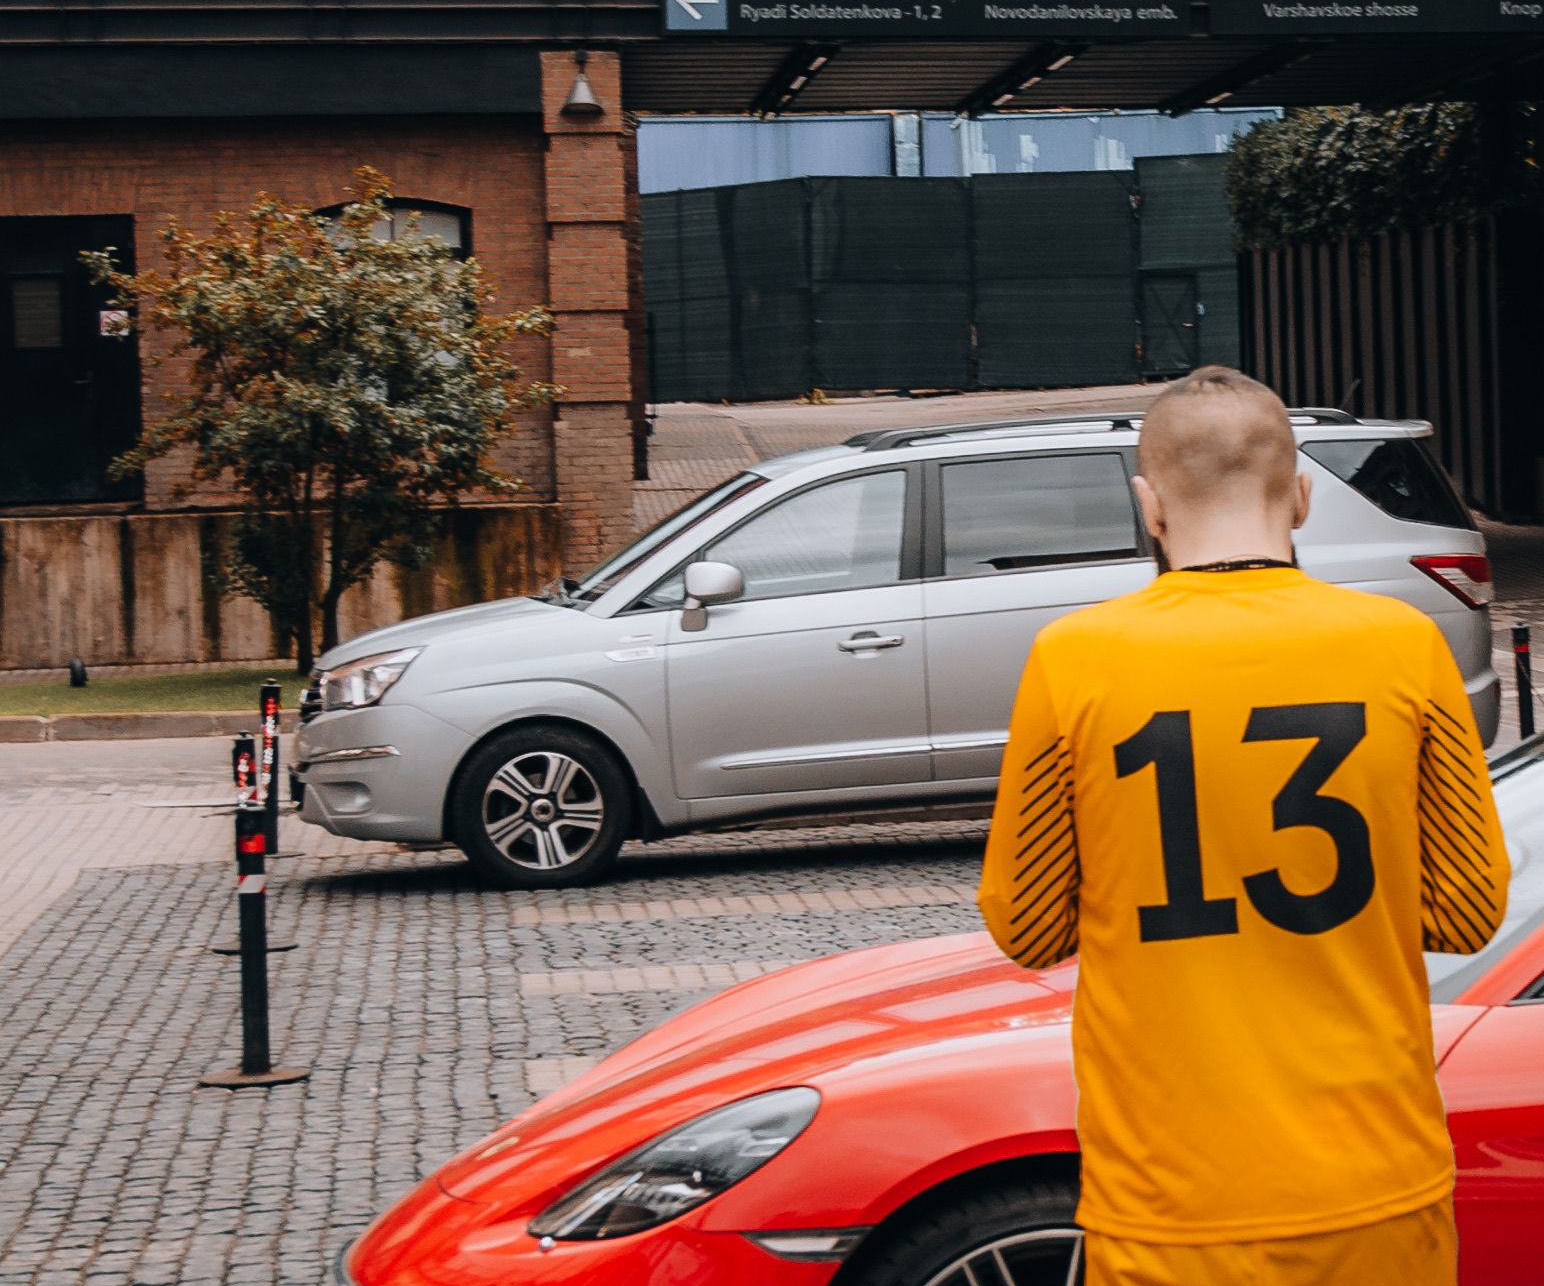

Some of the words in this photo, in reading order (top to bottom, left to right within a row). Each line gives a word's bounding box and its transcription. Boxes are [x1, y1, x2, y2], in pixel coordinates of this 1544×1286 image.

[740, 3, 787, 22] Ryadi
[931, 4, 943, 19] 2
[984, 4, 1133, 22] Novodanilovskaya
[1136, 4, 1178, 20] emb.
[1263, 2, 1363, 18] Varshavskoe
[1365, 1, 1419, 17] shosse
[1499, 1, 1543, 18] Knop
[1113, 702, 1375, 943] 13
